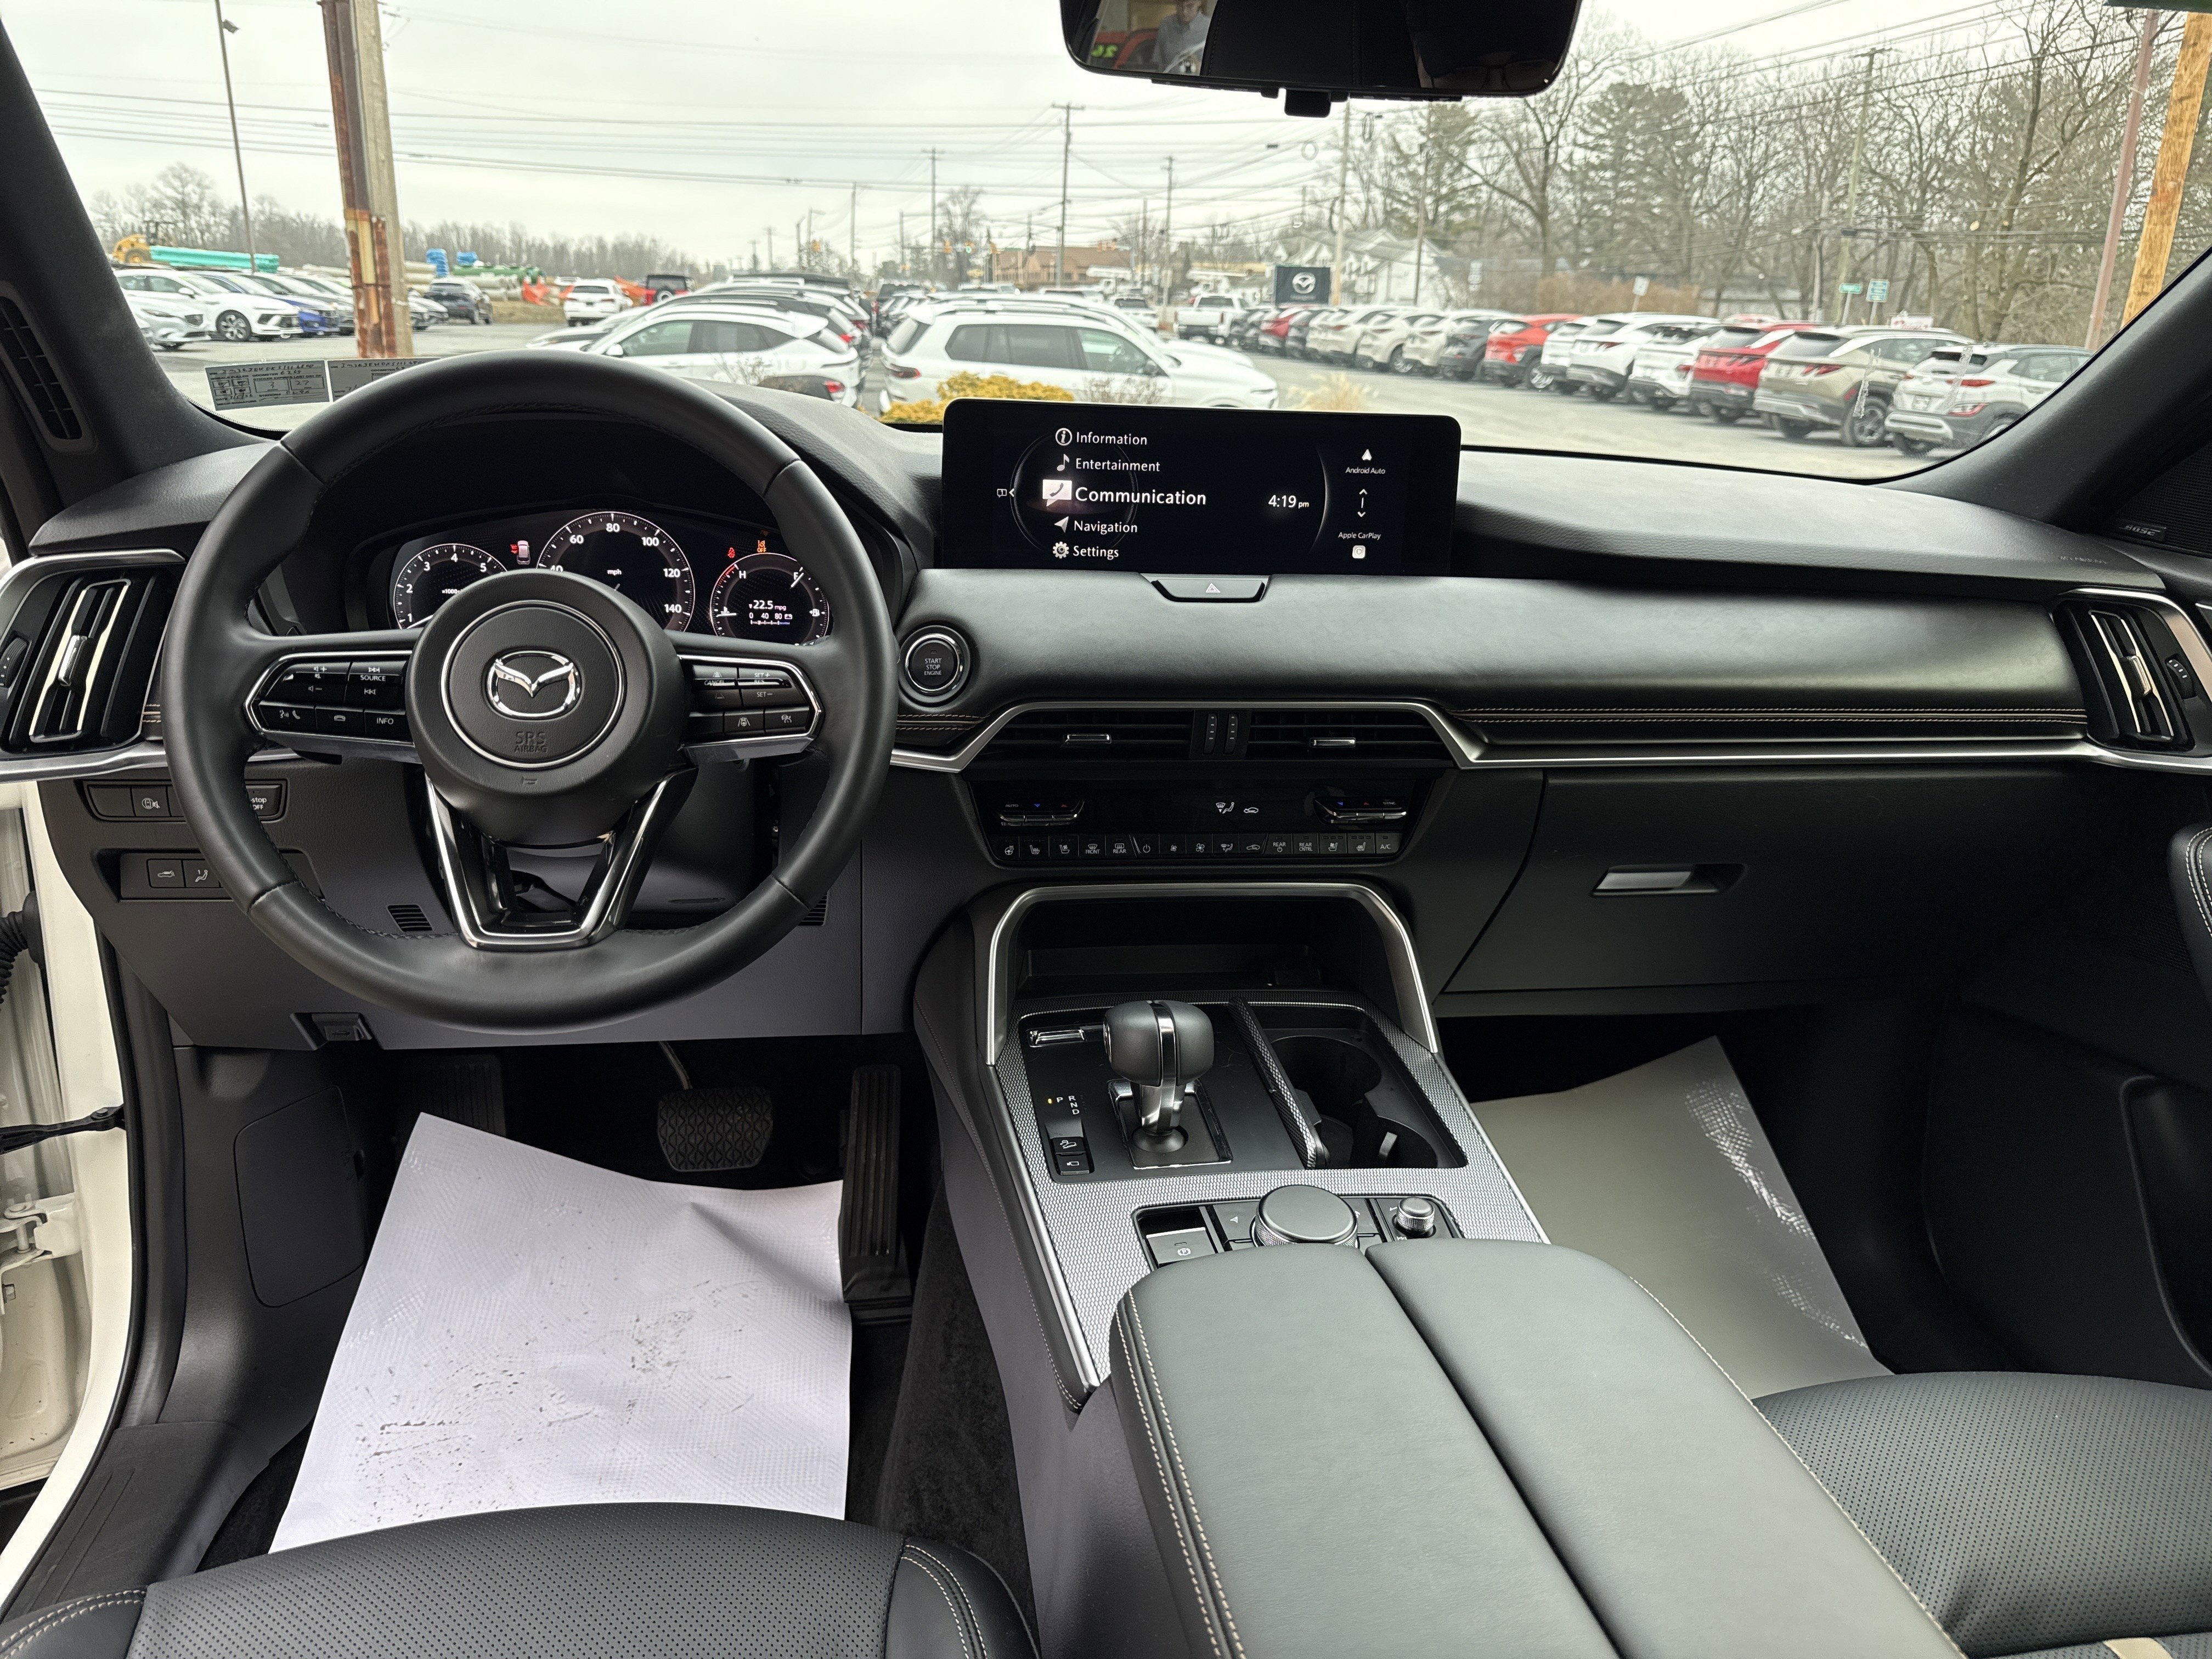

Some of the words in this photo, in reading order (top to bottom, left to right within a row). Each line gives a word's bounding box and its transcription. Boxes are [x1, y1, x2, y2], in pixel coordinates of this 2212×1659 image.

[1076, 432, 1147, 445] Information
[1075, 459, 1160, 473] Entertainment
[1075, 487, 1206, 506] Communication
[1268, 495, 1296, 508] 4:19
[606, 523, 620, 532] 80
[1074, 521, 1138, 534] Navigation
[569, 535, 584, 544] 60
[1358, 532, 1381, 540] CarPlay
[641, 537, 659, 546] 100
[1073, 545, 1119, 560] Settings
[450, 553, 458, 562] 4
[424, 562, 431, 571] 3
[479, 563, 487, 572] 5
[663, 568, 680, 578] 120
[738, 571, 746, 579] H
[406, 584, 413, 593] 2
[664, 604, 682, 613] 140
[753, 600, 774, 610] 22.5
[408, 613, 412, 622] 1
[515, 731, 546, 745] SRS
[514, 744, 548, 753] AIRBAG
